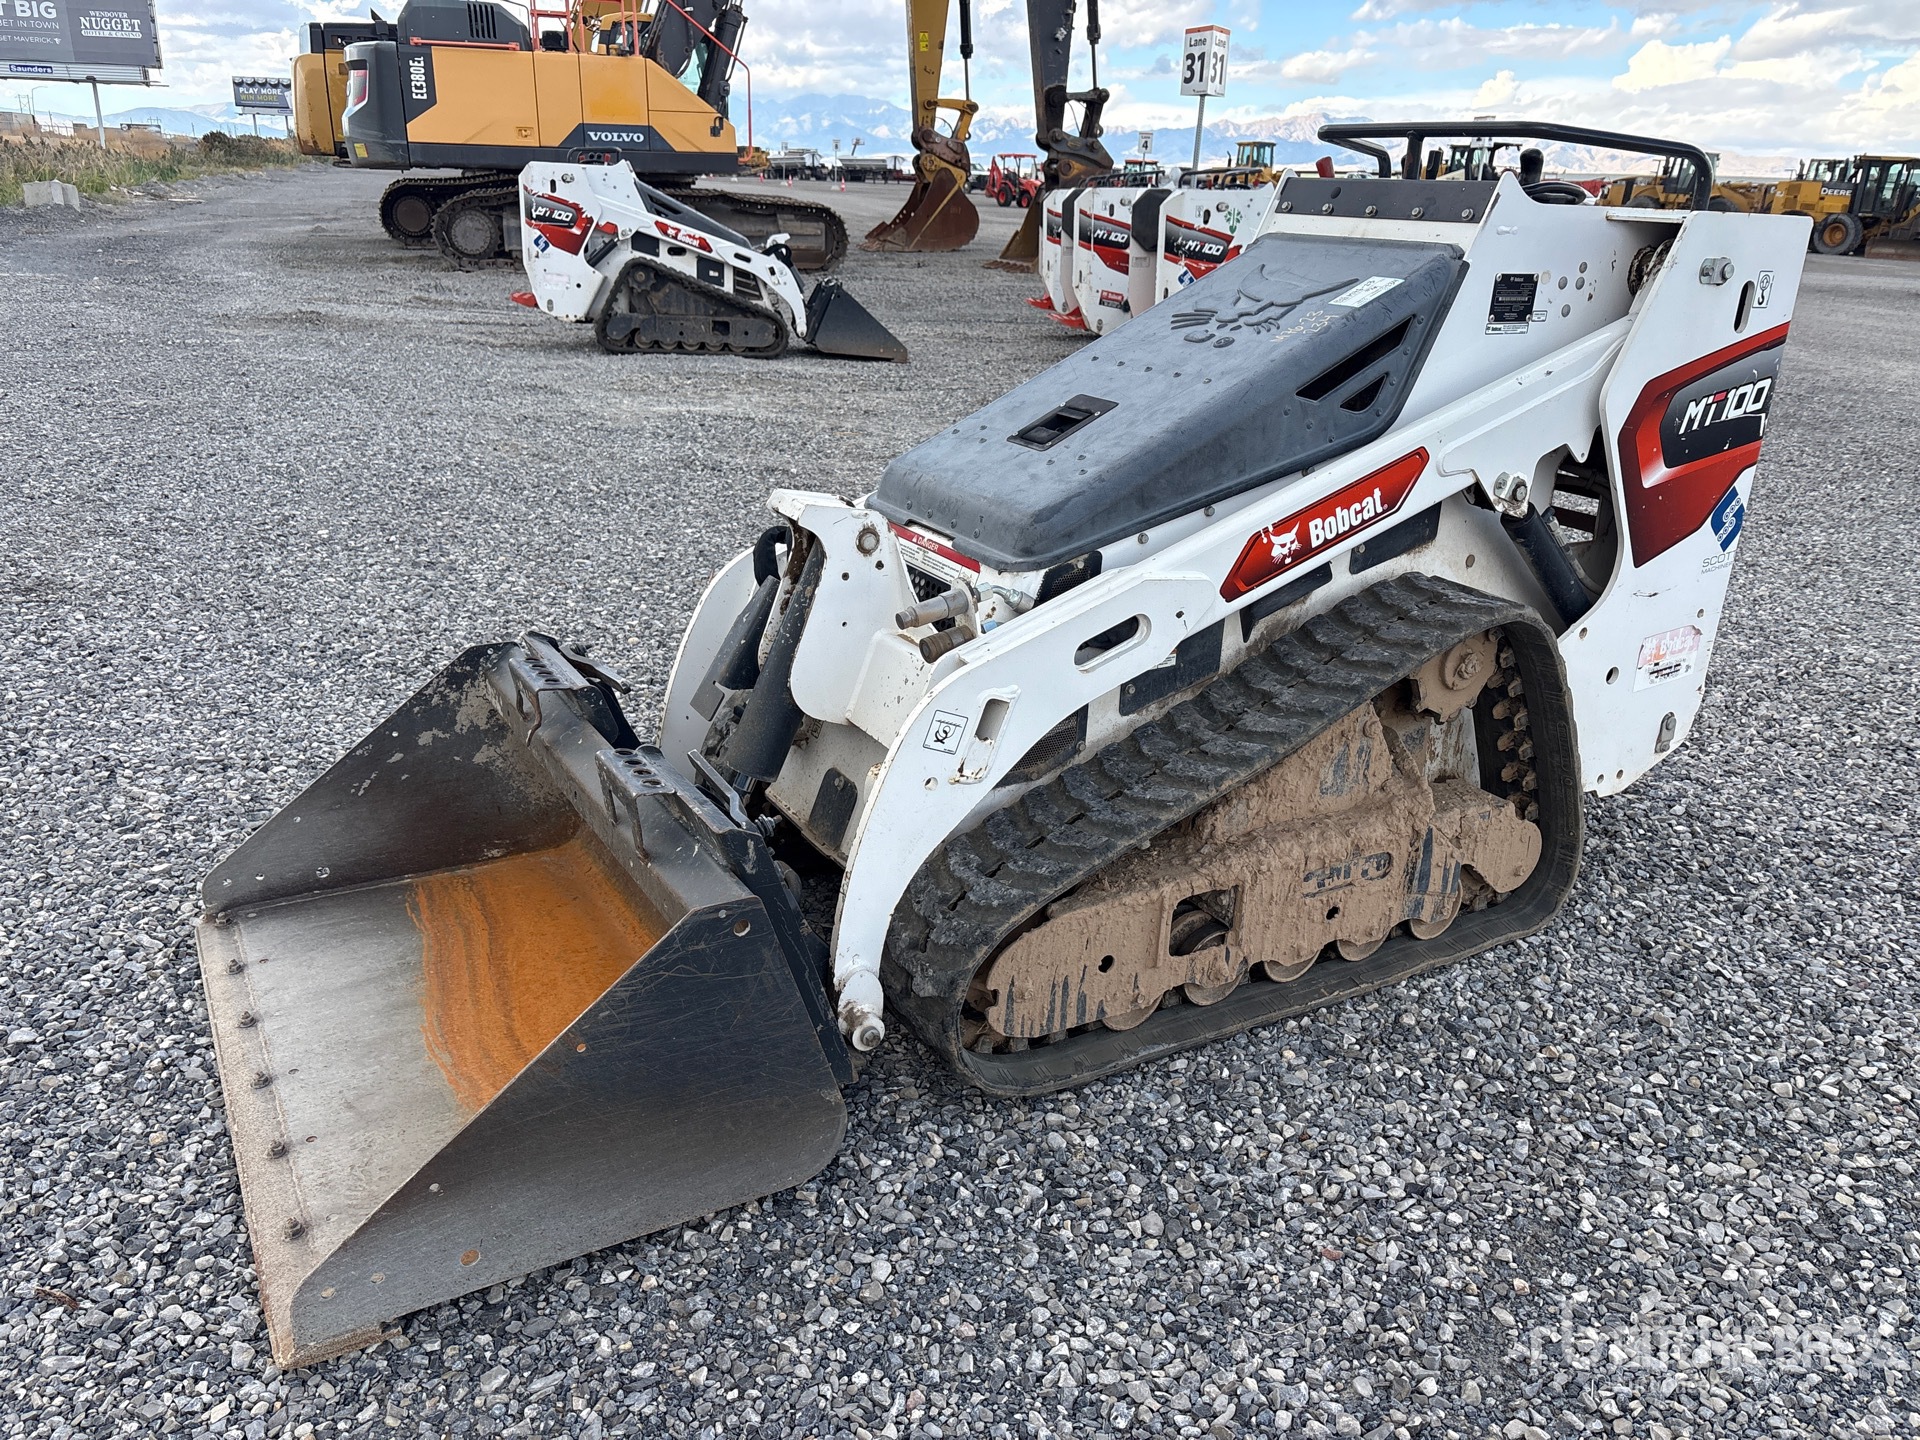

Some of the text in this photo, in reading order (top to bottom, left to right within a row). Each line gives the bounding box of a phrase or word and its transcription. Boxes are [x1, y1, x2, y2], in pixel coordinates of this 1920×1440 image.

[14, 0, 57, 19] BIG
[88, 10, 128, 18] WENDOVER
[30, 20, 60, 29] TOWN
[79, 16, 141, 31] NUGGET
[1189, 37, 1207, 48] Lane
[1215, 35, 1227, 49] Lane
[10, 64, 52, 74] Saunders
[1183, 51, 1206, 85] 31
[1210, 51, 1225, 85] 31
[409, 56, 428, 100] EC380EL
[239, 87, 258, 95] PLAY
[587, 131, 645, 143] VOLVO
[1142, 140, 1148, 151] 4
[1820, 187, 1853, 196] DEERE
[1094, 229, 1128, 243] MT100
[1185, 239, 1224, 256] MT100
[1678, 377, 1772, 435] MT100
[1308, 486, 1383, 549] Bobcat
[917, 536, 938, 552] DANGER
